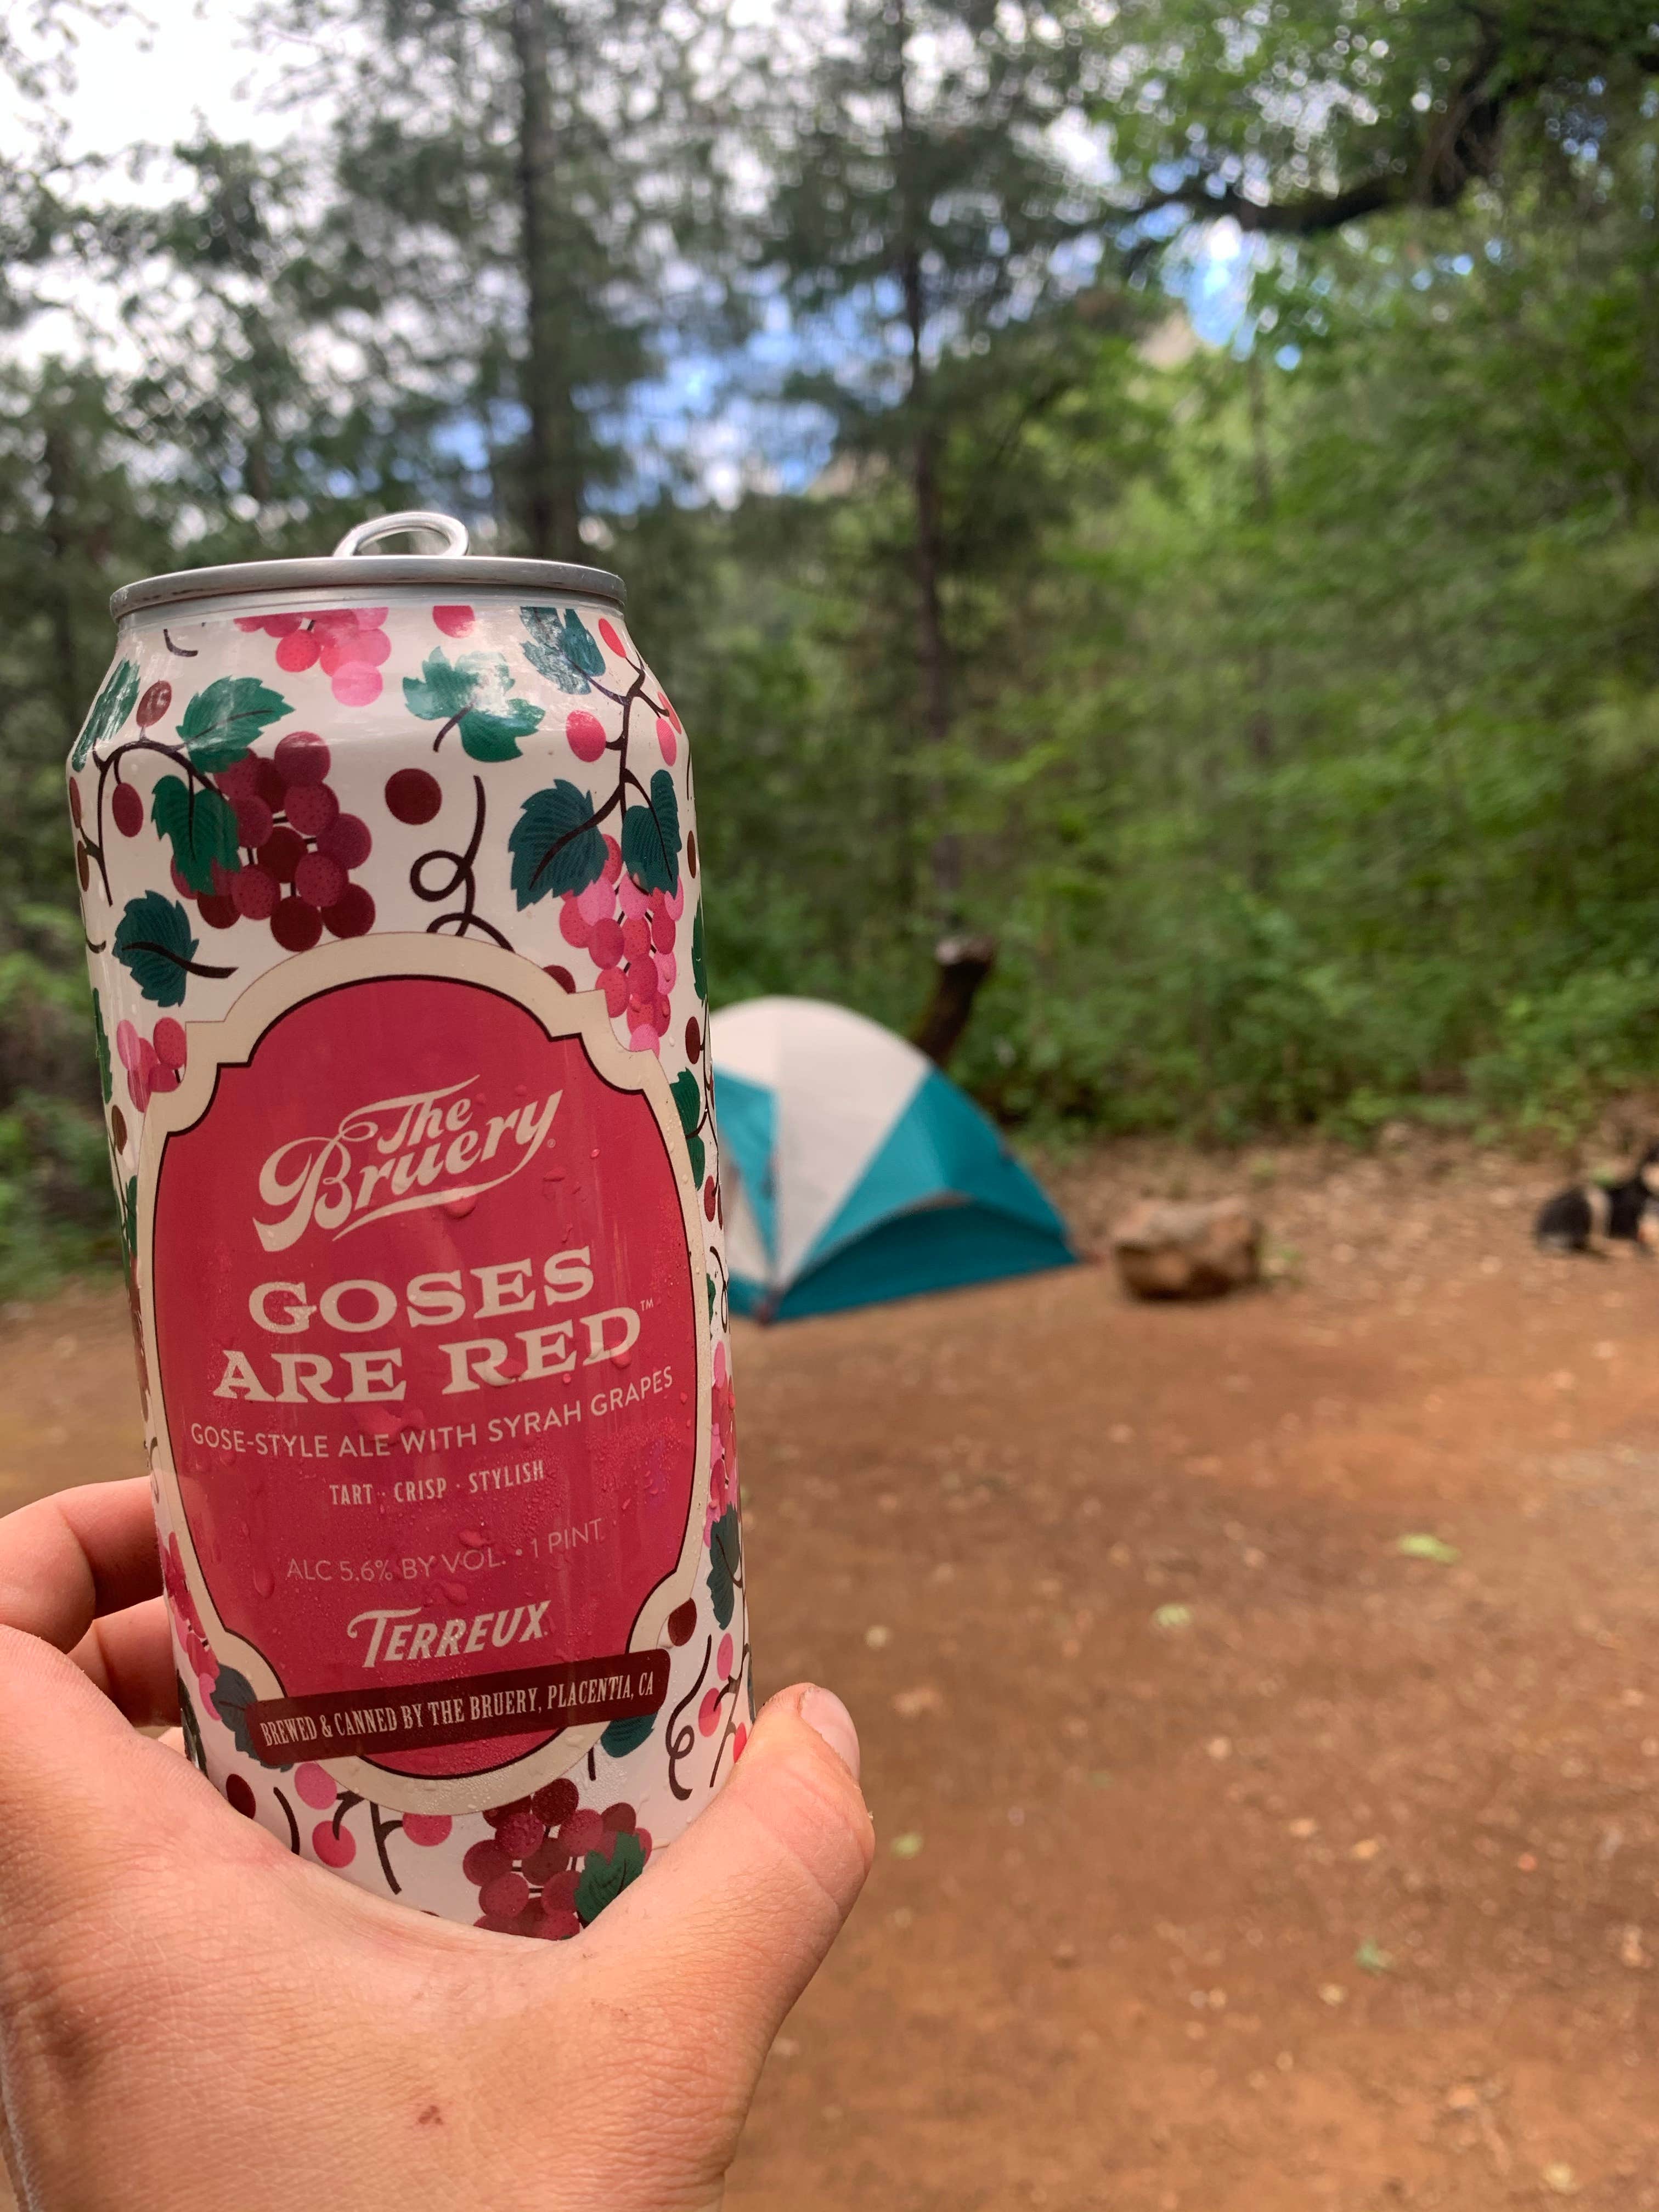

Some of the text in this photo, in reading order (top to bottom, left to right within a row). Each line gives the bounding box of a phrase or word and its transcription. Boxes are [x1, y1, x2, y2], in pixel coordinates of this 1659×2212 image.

[339, 1074, 481, 1154] The
[252, 1089, 563, 1252] Bruery
[248, 1245, 594, 1335] GOSES
[212, 1347, 408, 1404] ARE
[439, 1306, 641, 1396] RED
[190, 1365, 673, 1458] GOSE-STYLE ALE WITH SYRAH GRAPES
[329, 1459, 544, 1506] TART CRISP STYLISH
[287, 1517, 602, 1582] ALC 5.6% BY VOL. 1 PINT
[259, 1671, 654, 1747] BREWED & CANNED BY THE BRUERY, PLACENTIA, CA
